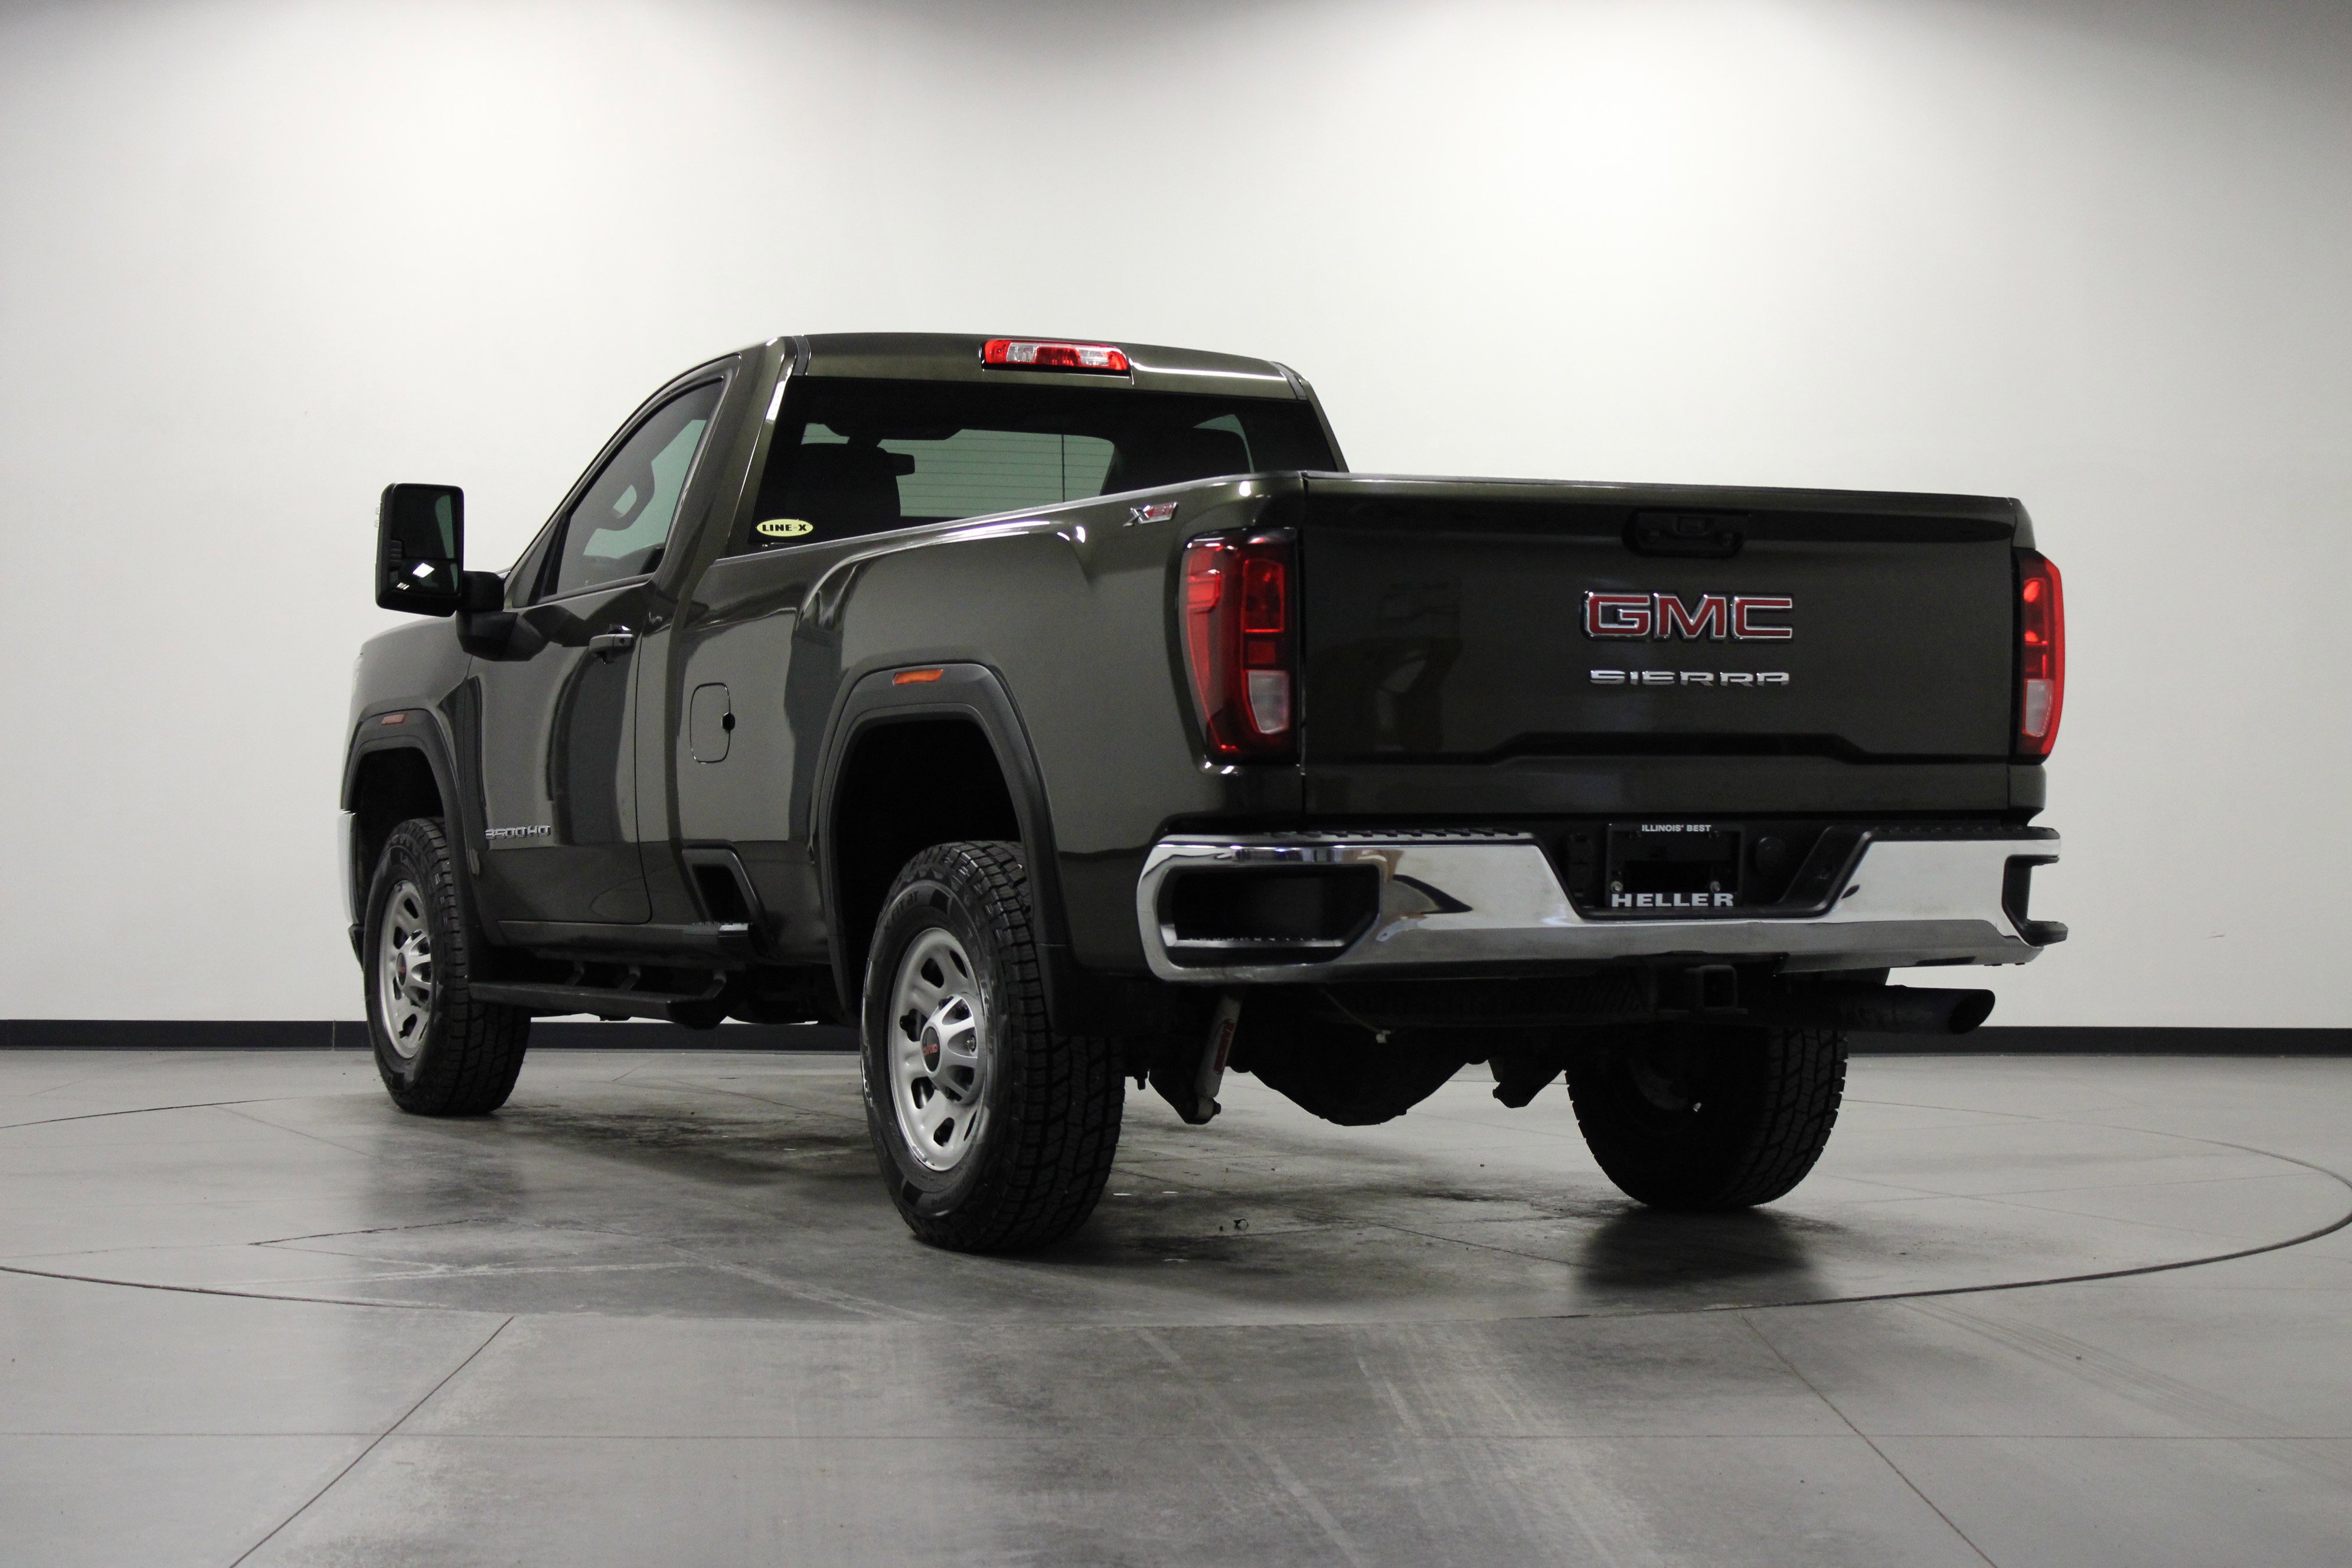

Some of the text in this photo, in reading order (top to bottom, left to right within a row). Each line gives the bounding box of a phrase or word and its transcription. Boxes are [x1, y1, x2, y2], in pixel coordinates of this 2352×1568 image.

[1583, 591, 1793, 640] GMC
[1590, 669, 1789, 687] SIERRA
[1612, 893, 1734, 907] HELLER
